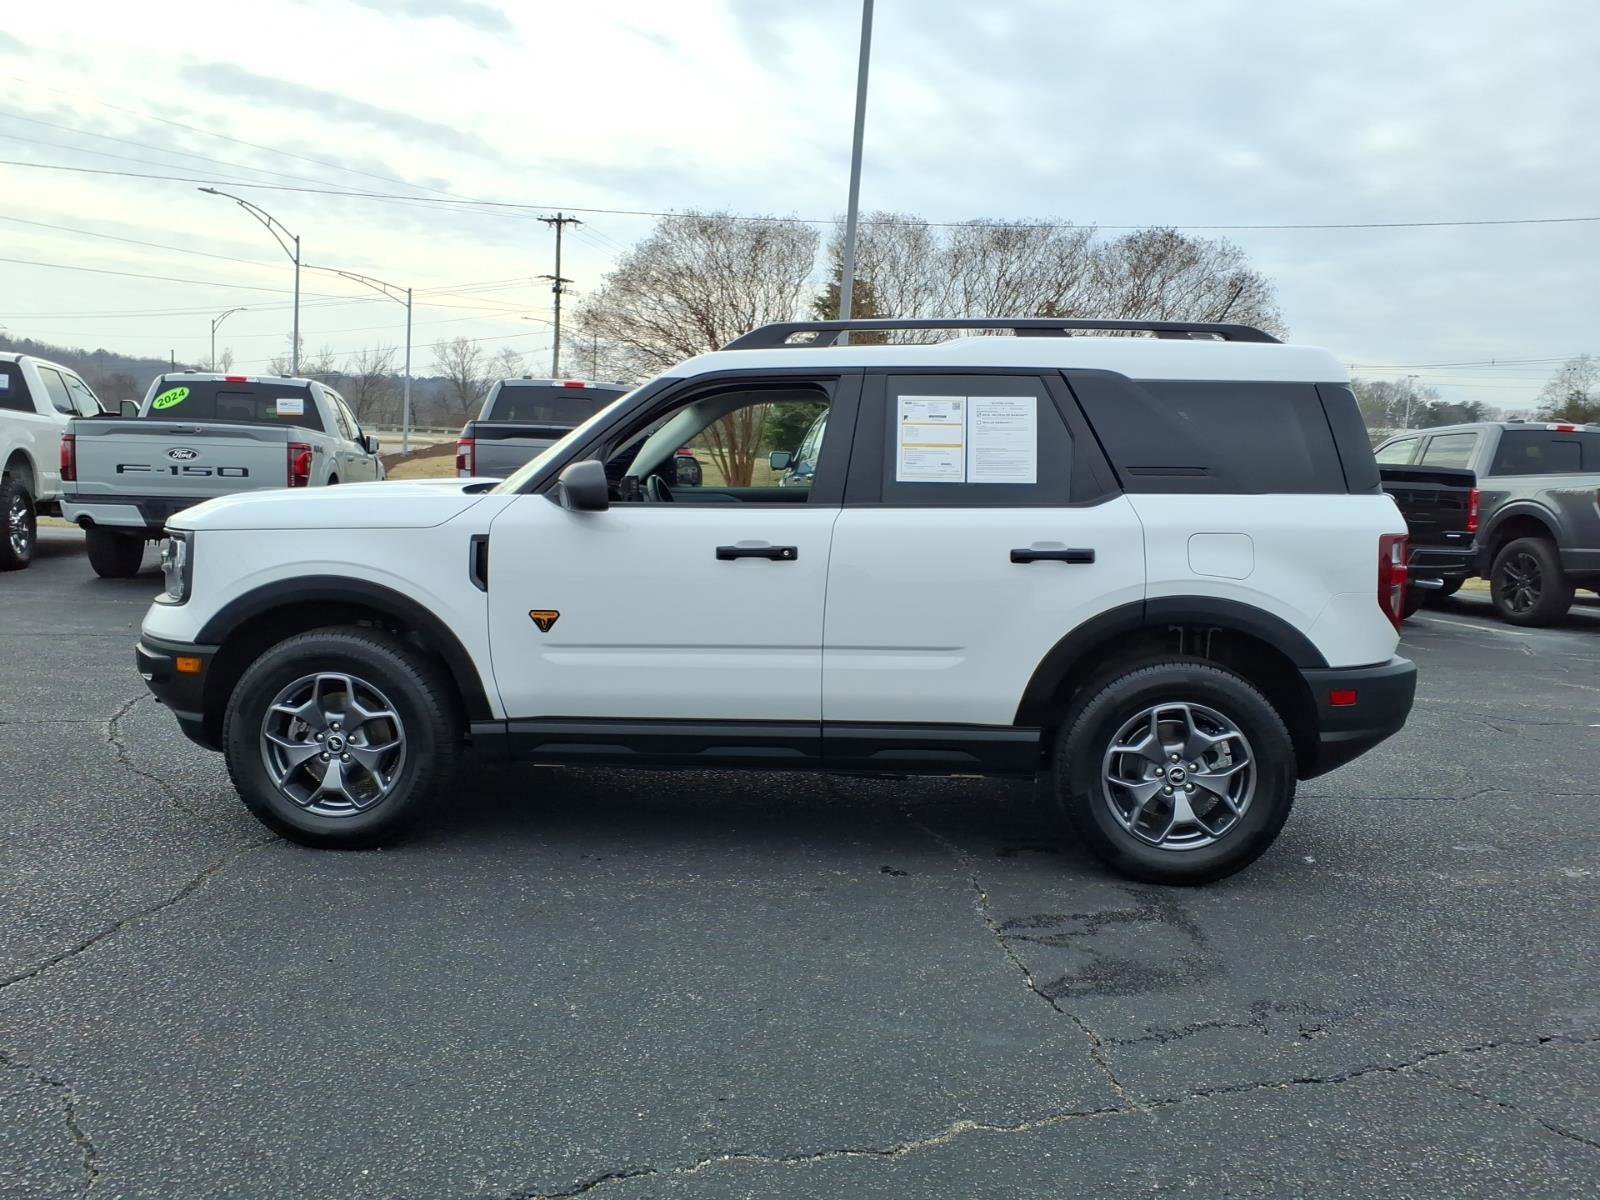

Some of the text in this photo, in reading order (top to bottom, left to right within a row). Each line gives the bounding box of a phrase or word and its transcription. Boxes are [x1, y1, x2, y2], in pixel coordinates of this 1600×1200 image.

[156, 388, 187, 408] 2024
[171, 449, 194, 460] Ford
[116, 463, 249, 478] F-150
